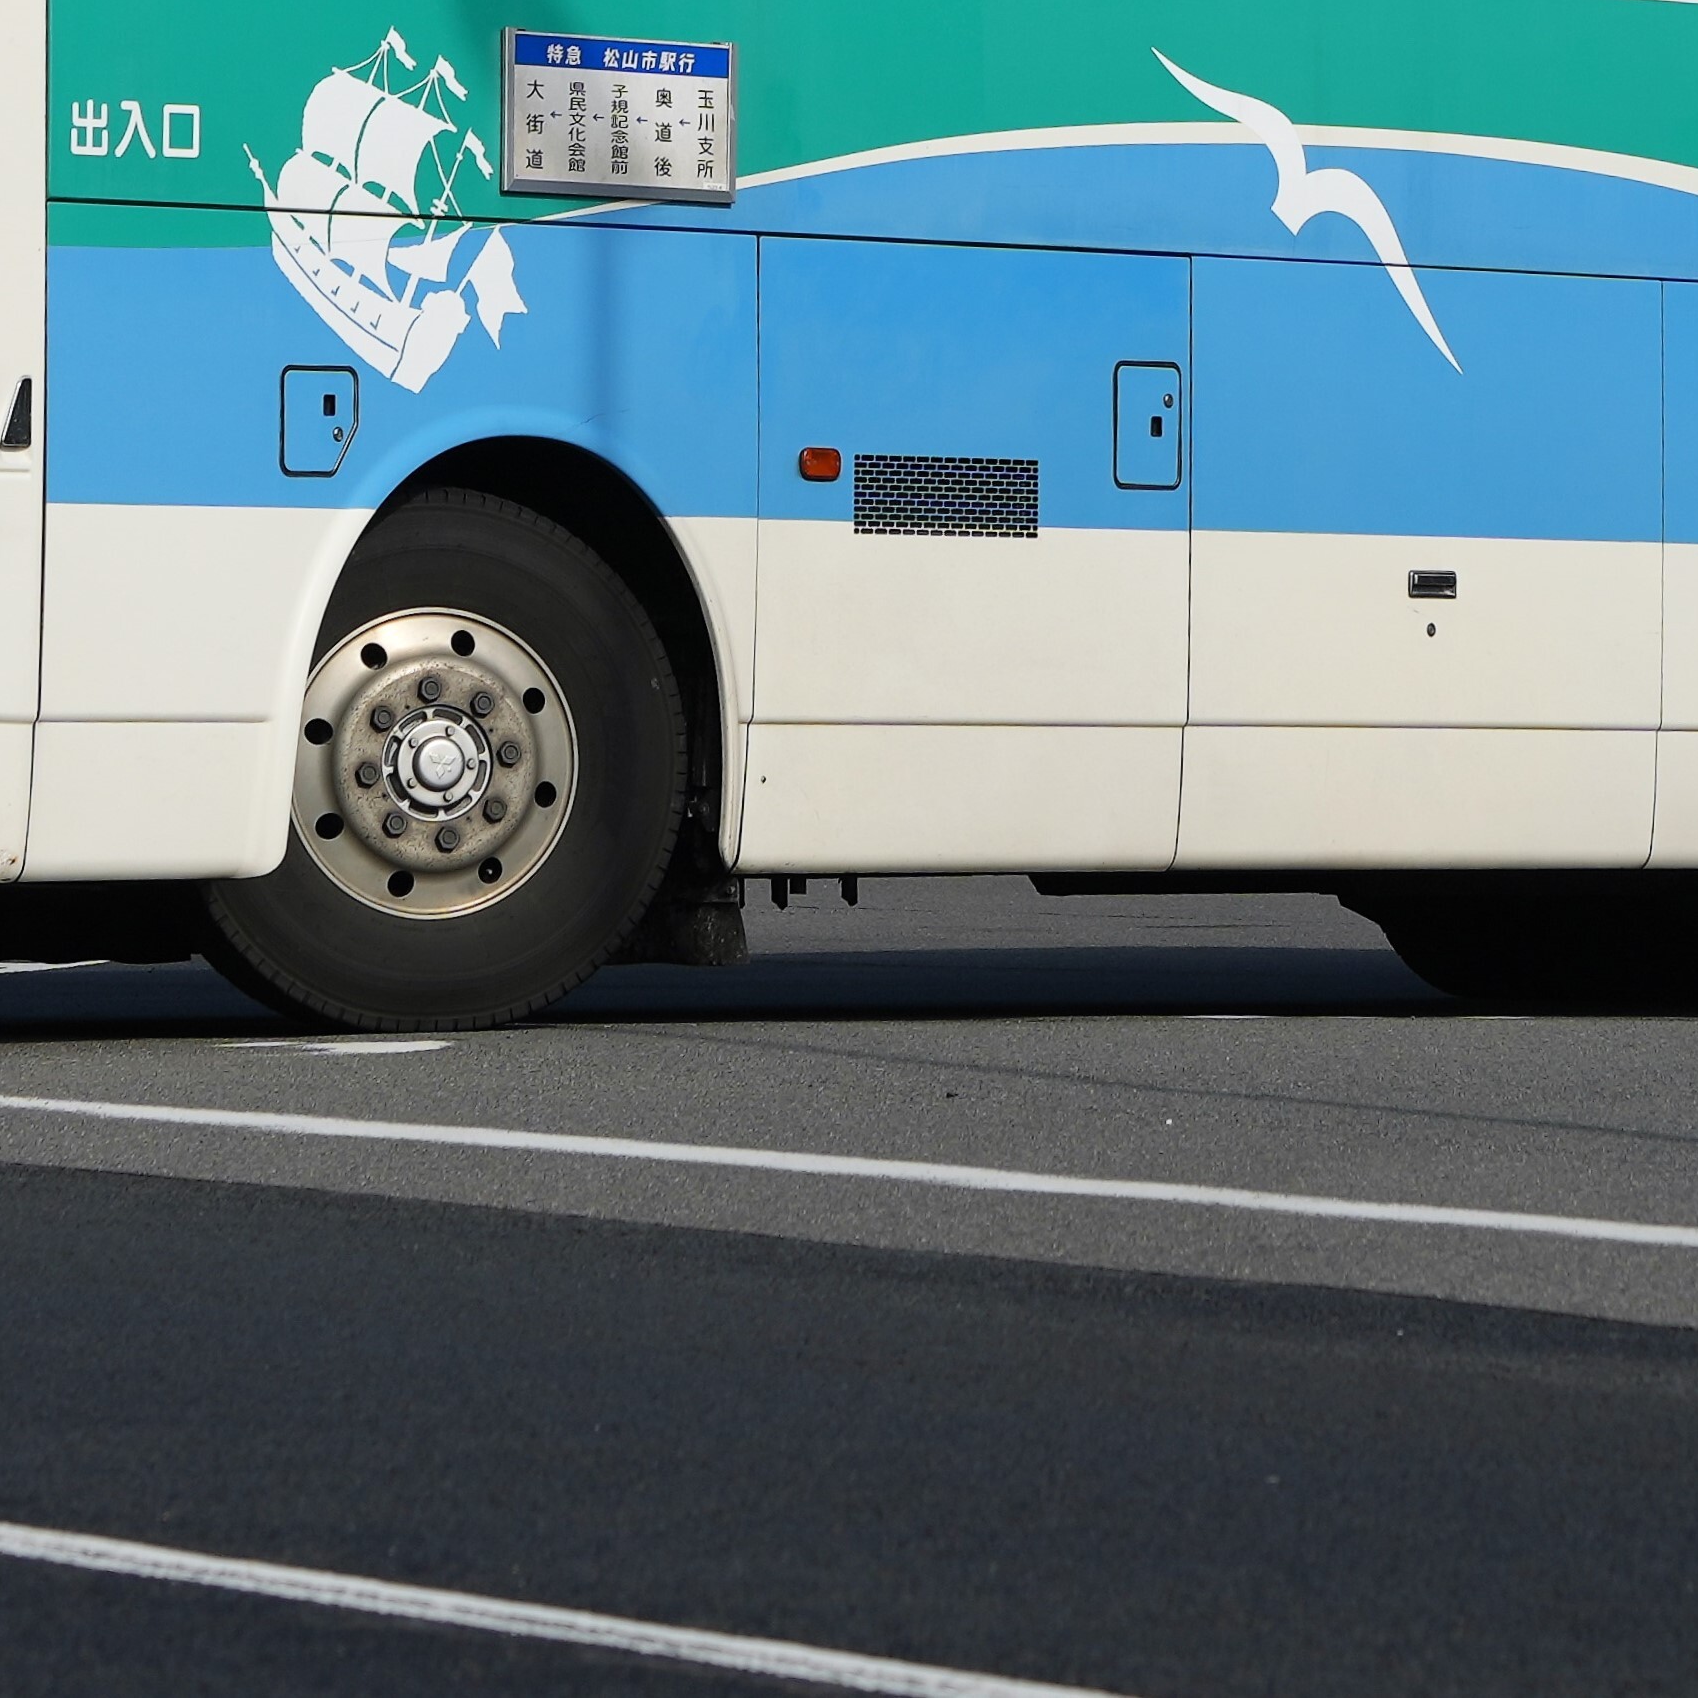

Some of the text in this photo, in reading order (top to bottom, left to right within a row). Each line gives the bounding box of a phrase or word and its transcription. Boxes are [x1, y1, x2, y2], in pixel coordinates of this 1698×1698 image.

[546, 44, 696, 73] 特急 松山市駅行
[70, 99, 200, 159] 出入口
[525, 79, 544, 169] 大街道
[568, 82, 587, 173] 県民文化会館
[610, 84, 629, 175] 子規記念館前
[654, 88, 673, 177] 奥道後
[697, 89, 715, 179] 玉川支所
